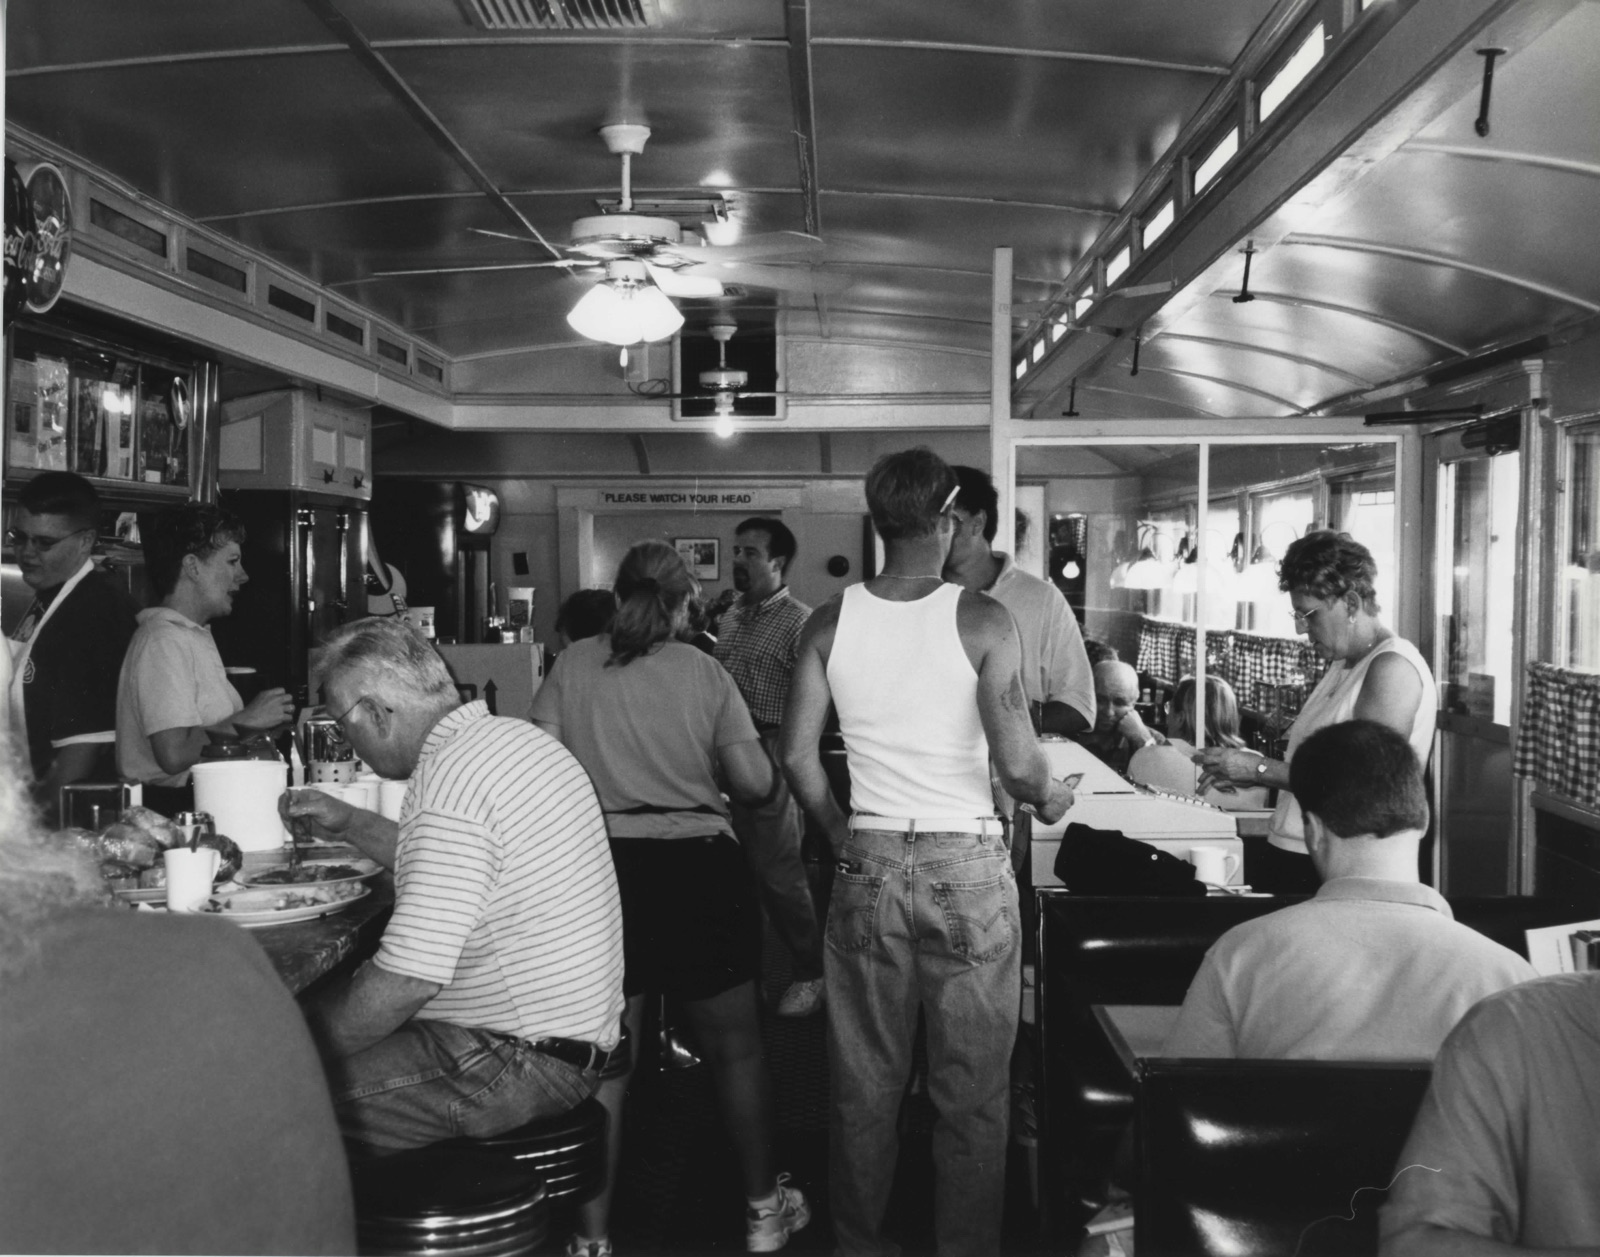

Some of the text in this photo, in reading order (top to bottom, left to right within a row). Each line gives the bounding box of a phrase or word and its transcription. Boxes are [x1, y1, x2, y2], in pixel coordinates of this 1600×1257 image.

[605, 493, 751, 504] PLEASE WATCH YOUR HEAD
